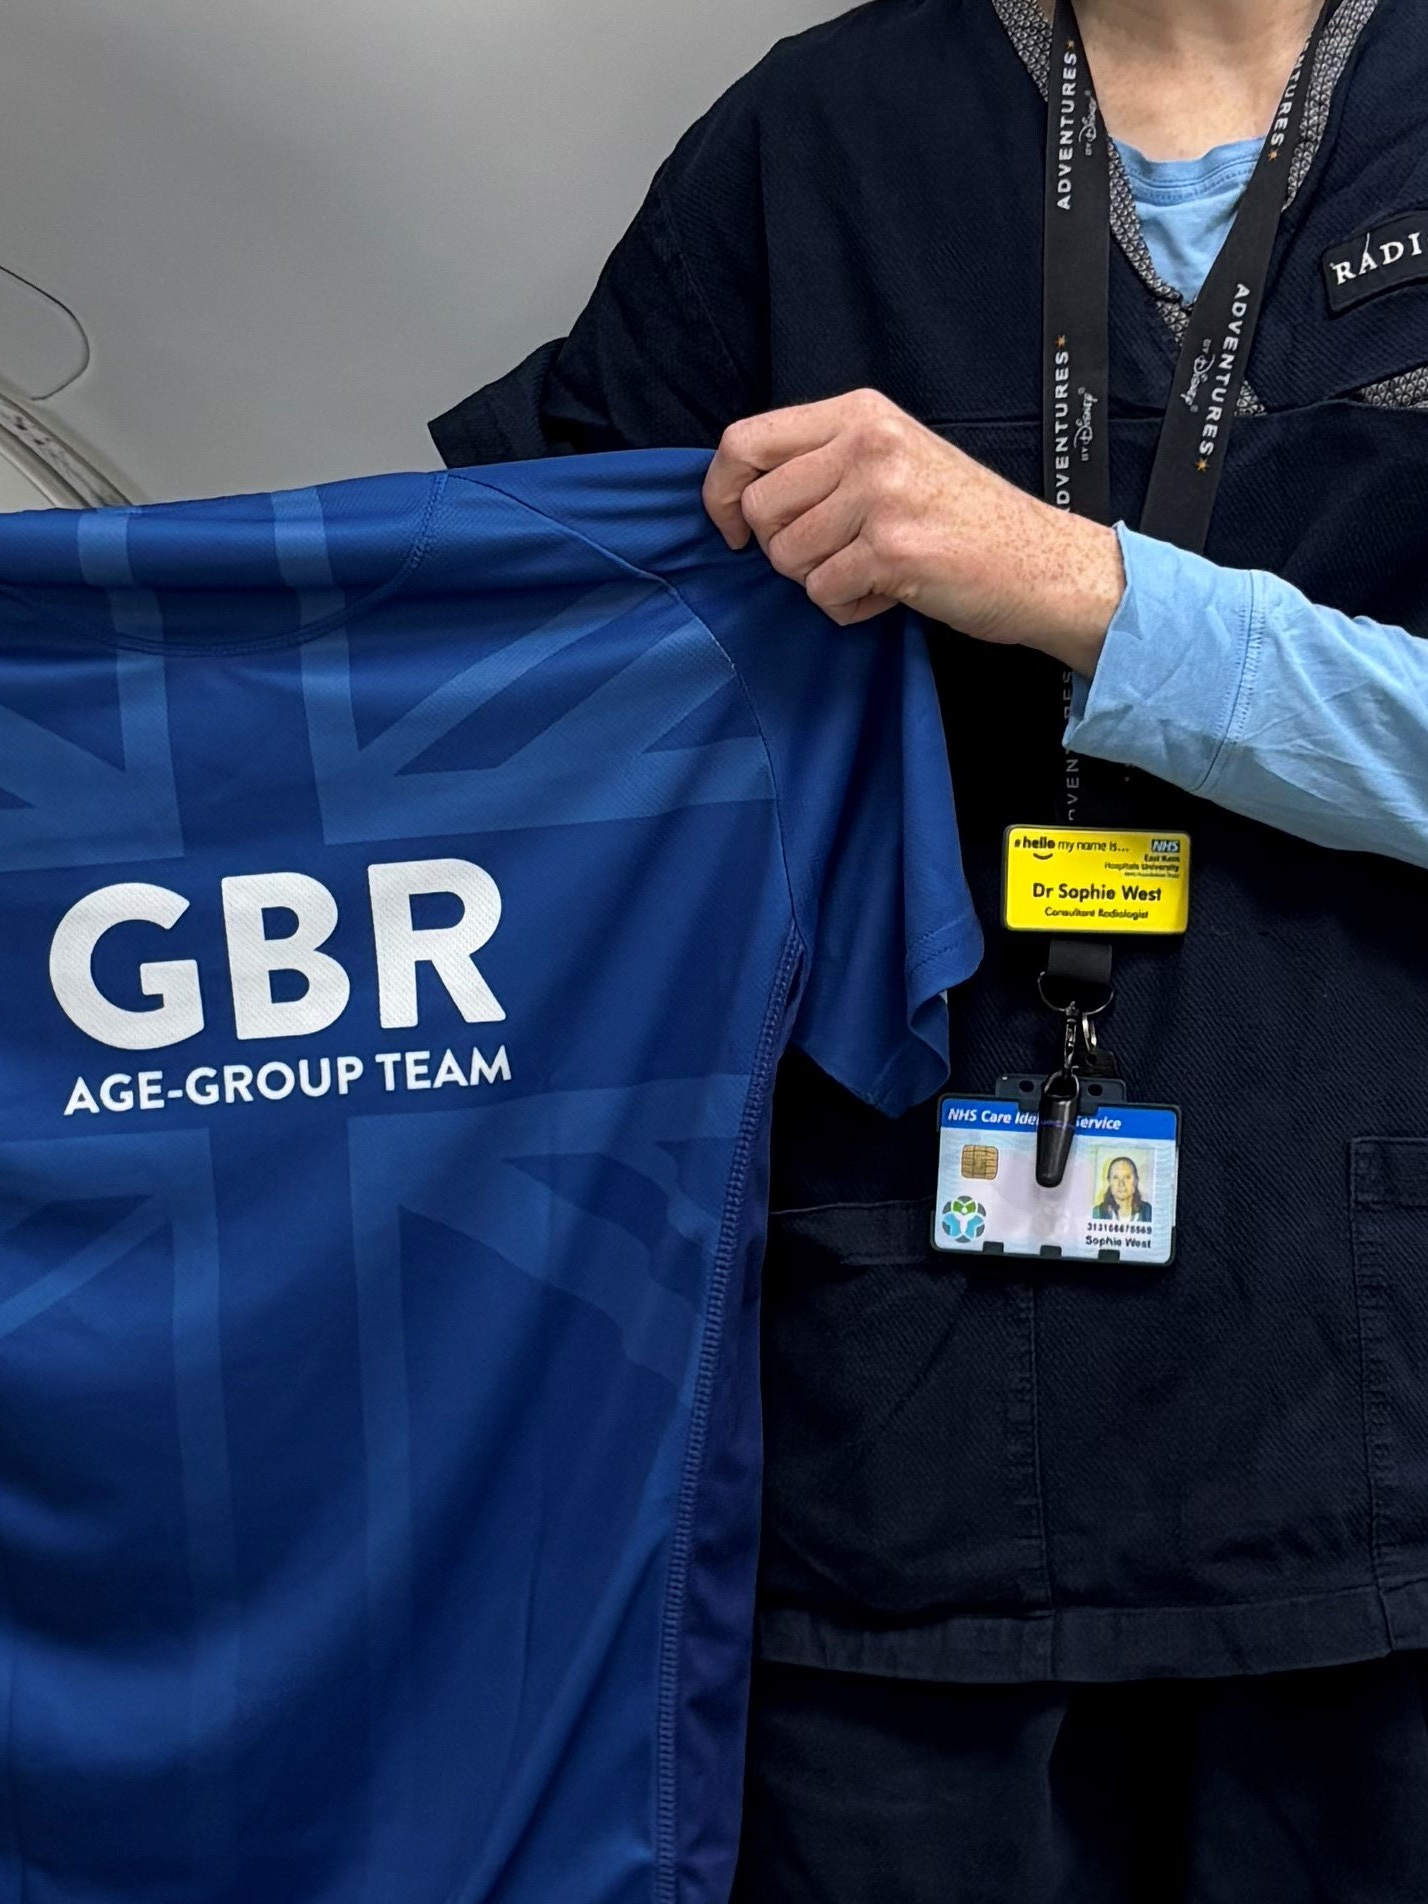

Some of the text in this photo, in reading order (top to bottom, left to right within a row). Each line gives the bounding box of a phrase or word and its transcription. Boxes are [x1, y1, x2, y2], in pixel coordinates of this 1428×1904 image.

[1056, 51, 1077, 211] ADVENTURES
[1199, 284, 1250, 457] ADVENTURES
[1054, 350, 1071, 512] DVENTURES
[1058, 840, 1074, 853] my
[1077, 841, 1107, 852] name
[1151, 839, 1180, 853] NHS
[1141, 863, 1180, 873] University
[1032, 882, 1162, 903] Dr Sophie West
[48, 857, 507, 1051] GBR
[62, 1044, 512, 1117] AGE-GROUP TEAM
[947, 1107, 977, 1122] NHS
[981, 1109, 1012, 1125] Care
[1015, 1111, 1040, 1127] Ide
[1085, 1235, 1151, 1249] Sophie West
